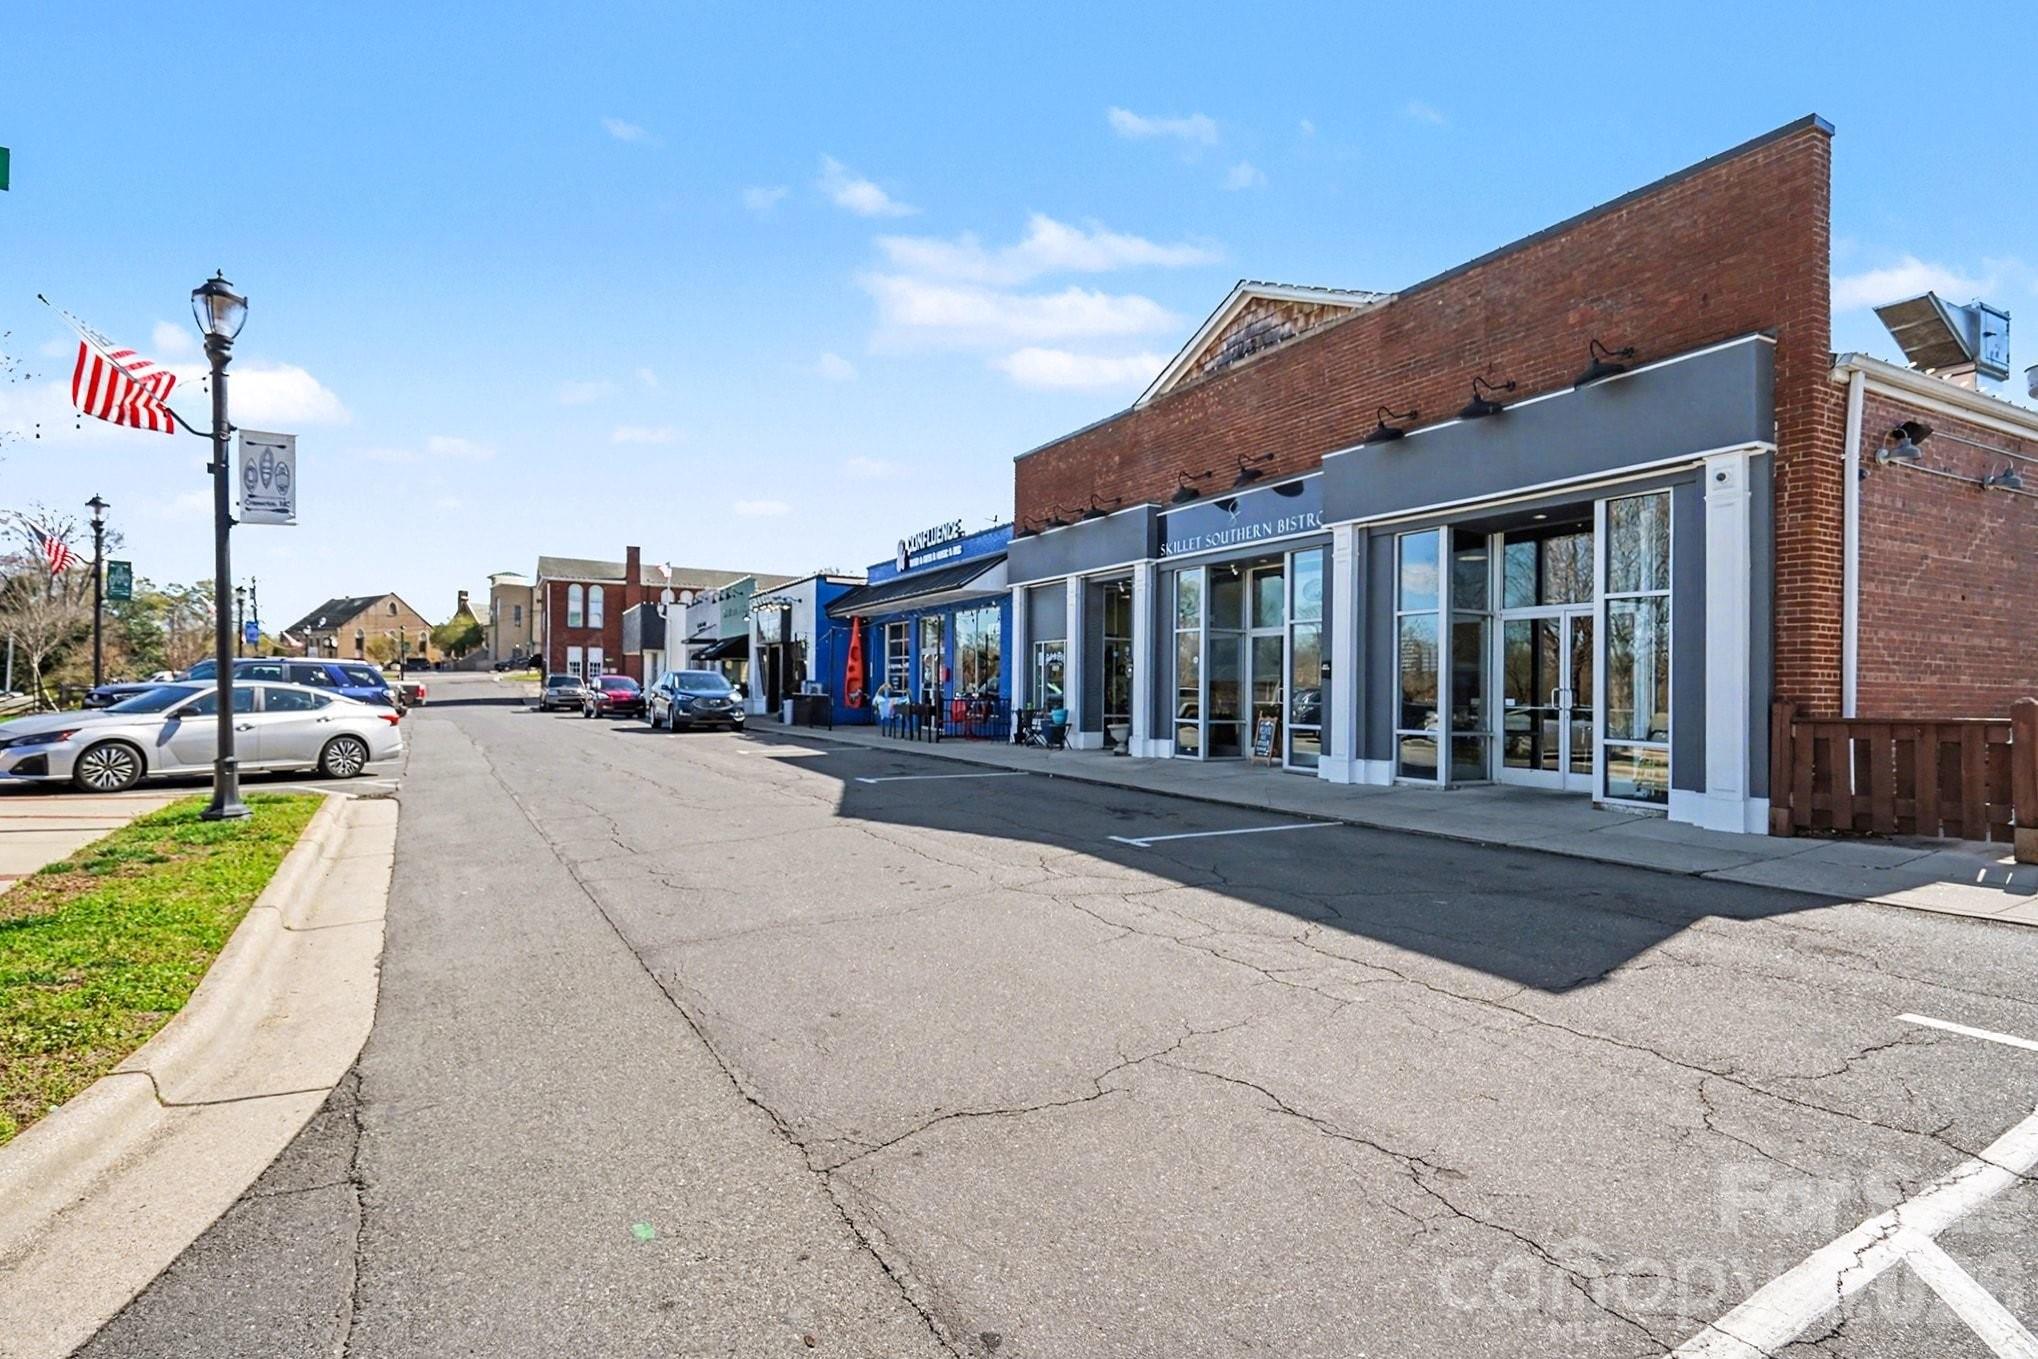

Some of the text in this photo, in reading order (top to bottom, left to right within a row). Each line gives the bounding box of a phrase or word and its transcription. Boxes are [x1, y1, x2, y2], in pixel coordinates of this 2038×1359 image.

[906, 519, 962, 556] CONFLUENCE
[1160, 535, 1202, 557] SKILLET
[1205, 522, 1272, 547] SOUTHERN
